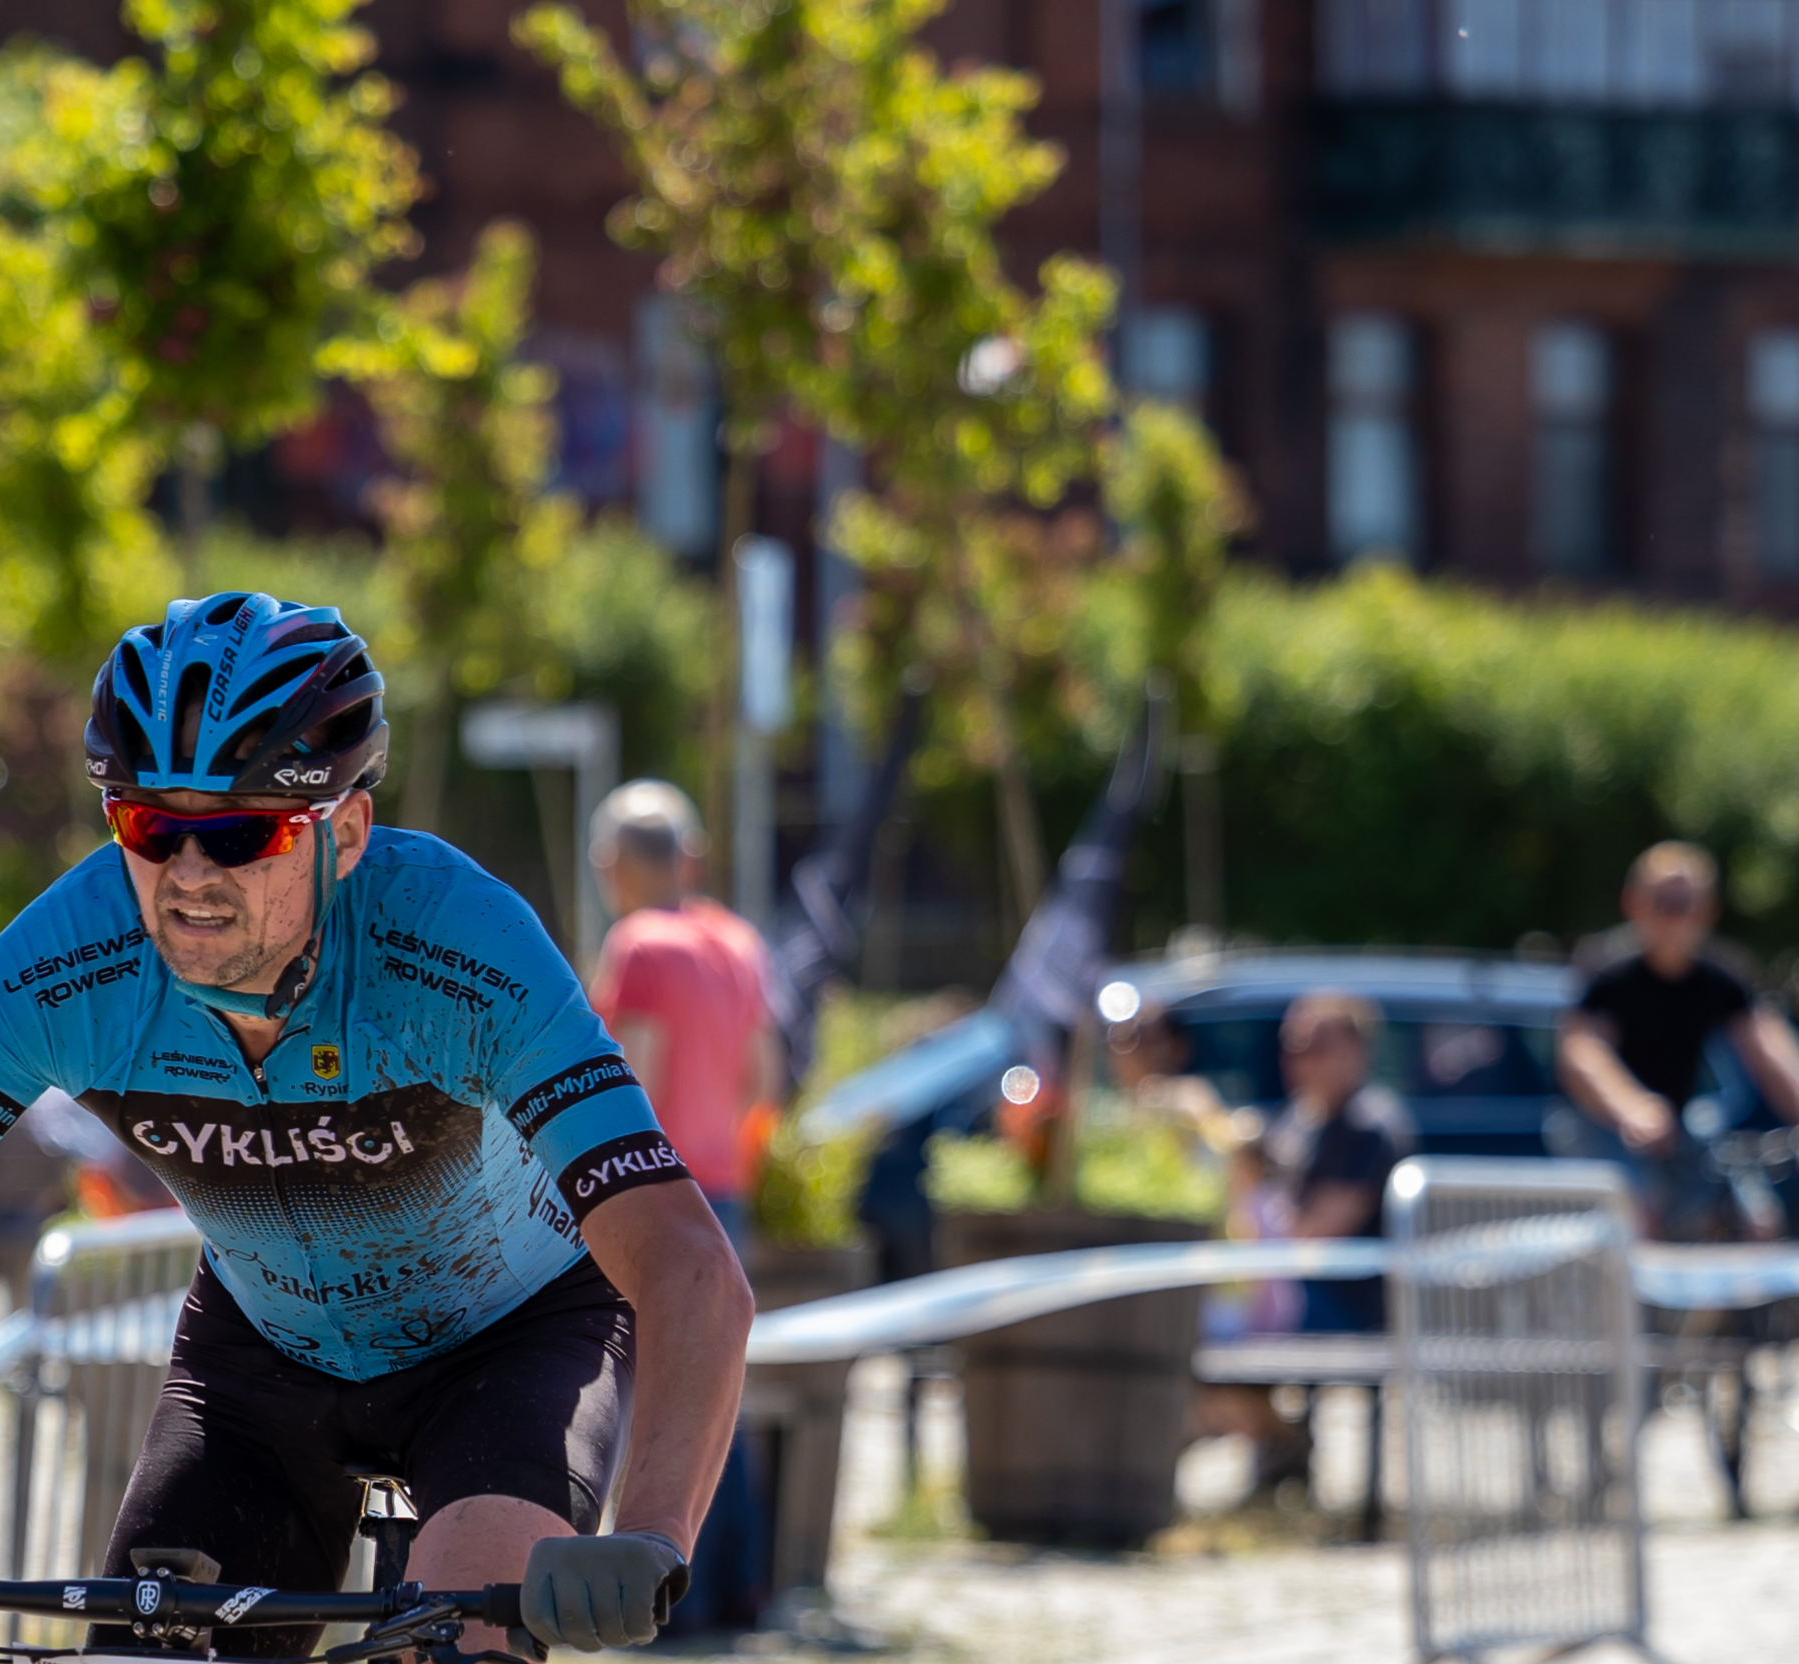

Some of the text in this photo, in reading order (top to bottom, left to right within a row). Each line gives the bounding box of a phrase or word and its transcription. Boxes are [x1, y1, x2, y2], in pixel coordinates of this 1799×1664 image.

[208, 647, 238, 723] CORSA
[3, 927, 144, 994] LEŚNIEWS
[369, 922, 529, 1003] LEŚNIEWSKI
[152, 1050, 238, 1075] LEŚNIEWSKI
[512, 1061, 622, 1132] Multi-Myjnia
[132, 1116, 415, 1168] CYKLIŚCI
